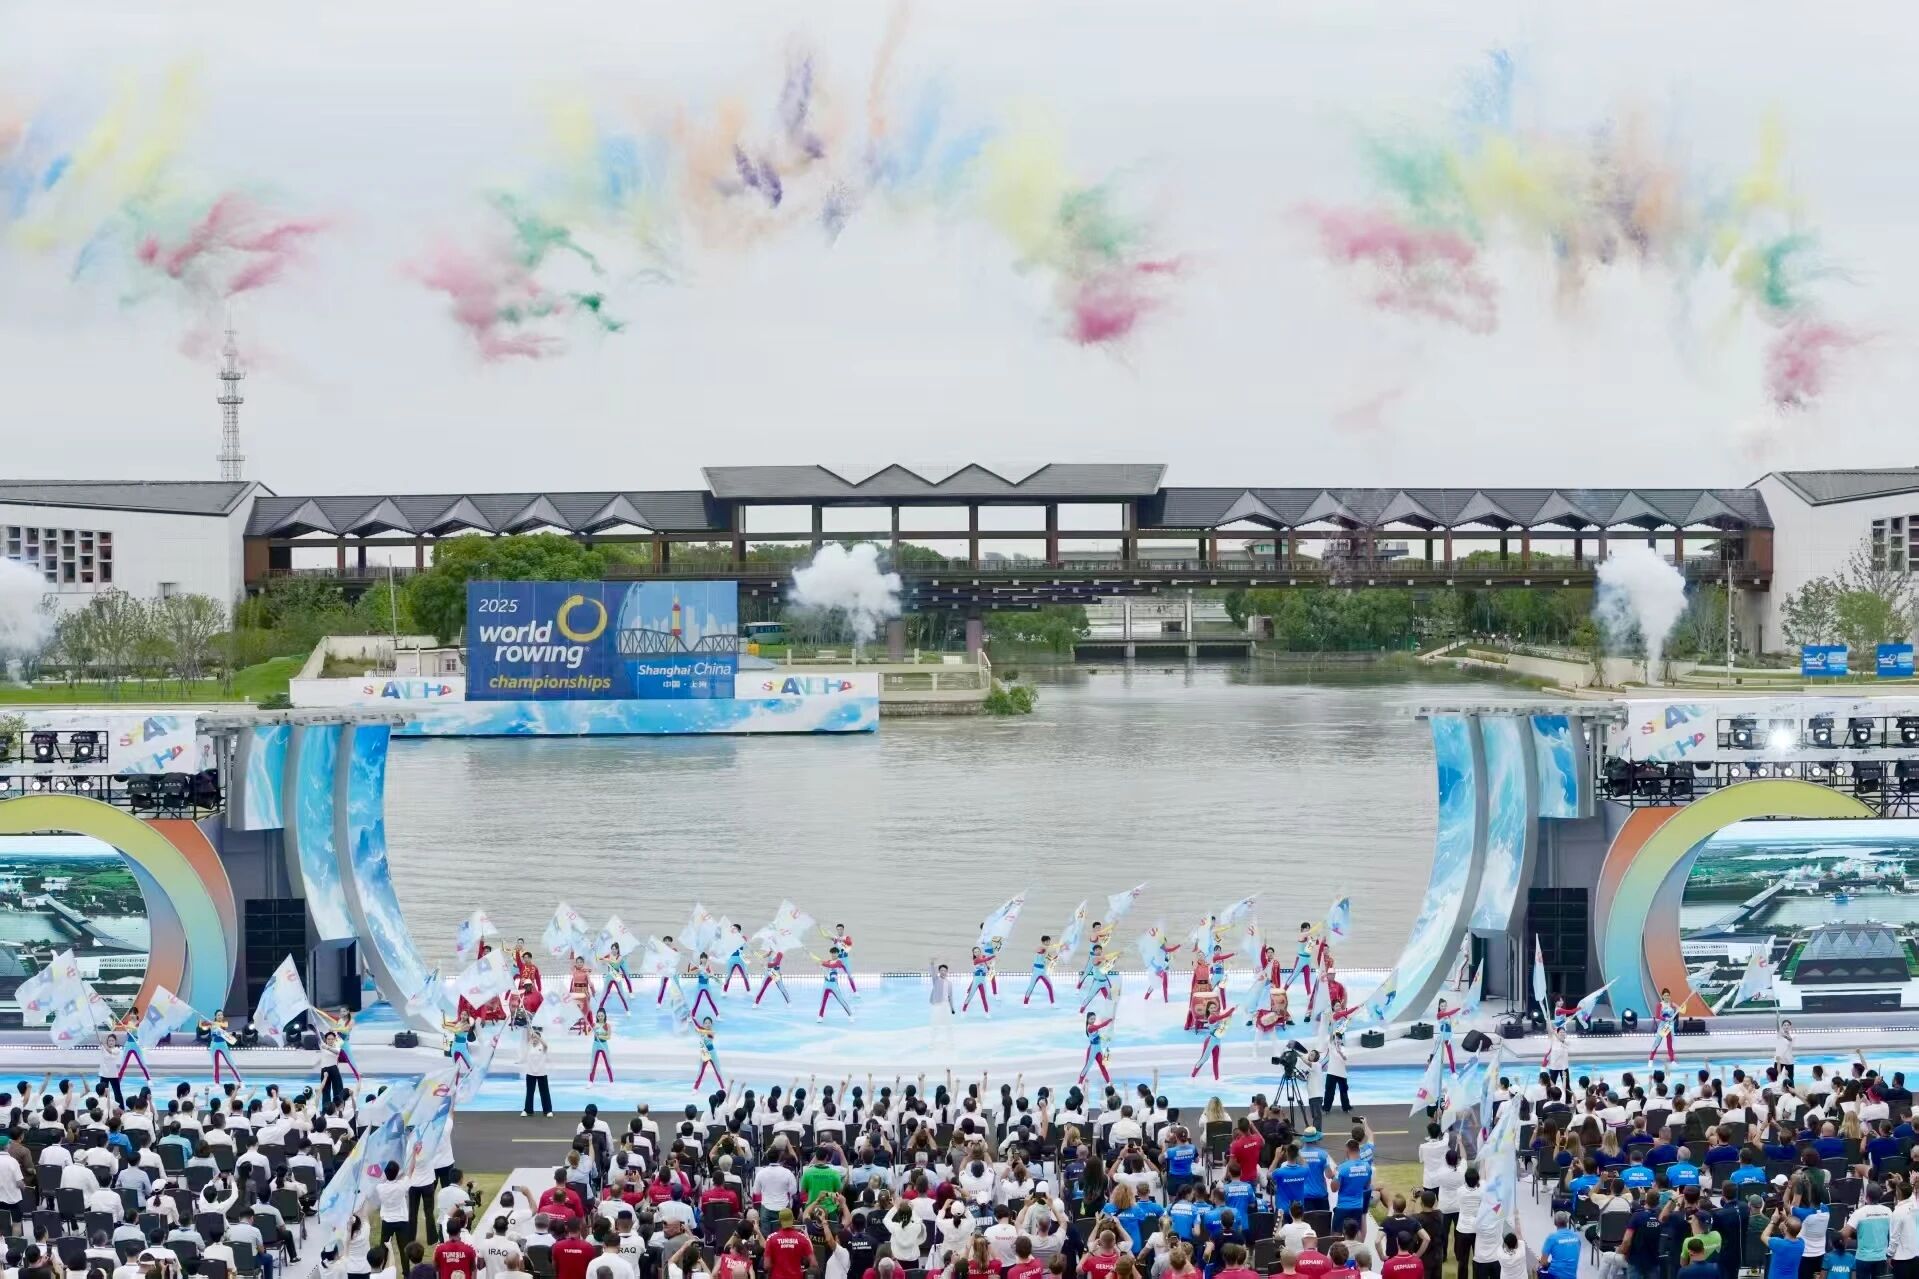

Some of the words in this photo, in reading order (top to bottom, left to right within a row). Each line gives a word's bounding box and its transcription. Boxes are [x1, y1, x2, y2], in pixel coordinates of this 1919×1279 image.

[479, 599, 518, 612] 2025
[480, 620, 553, 643] world
[495, 645, 584, 669] rowing
[638, 664, 692, 678] Shanghai
[694, 662, 732, 676] China
[489, 675, 611, 692] championships
[488, 1248, 509, 1257] IRAQ
[1393, 1263, 1417, 1271] GERMANY
